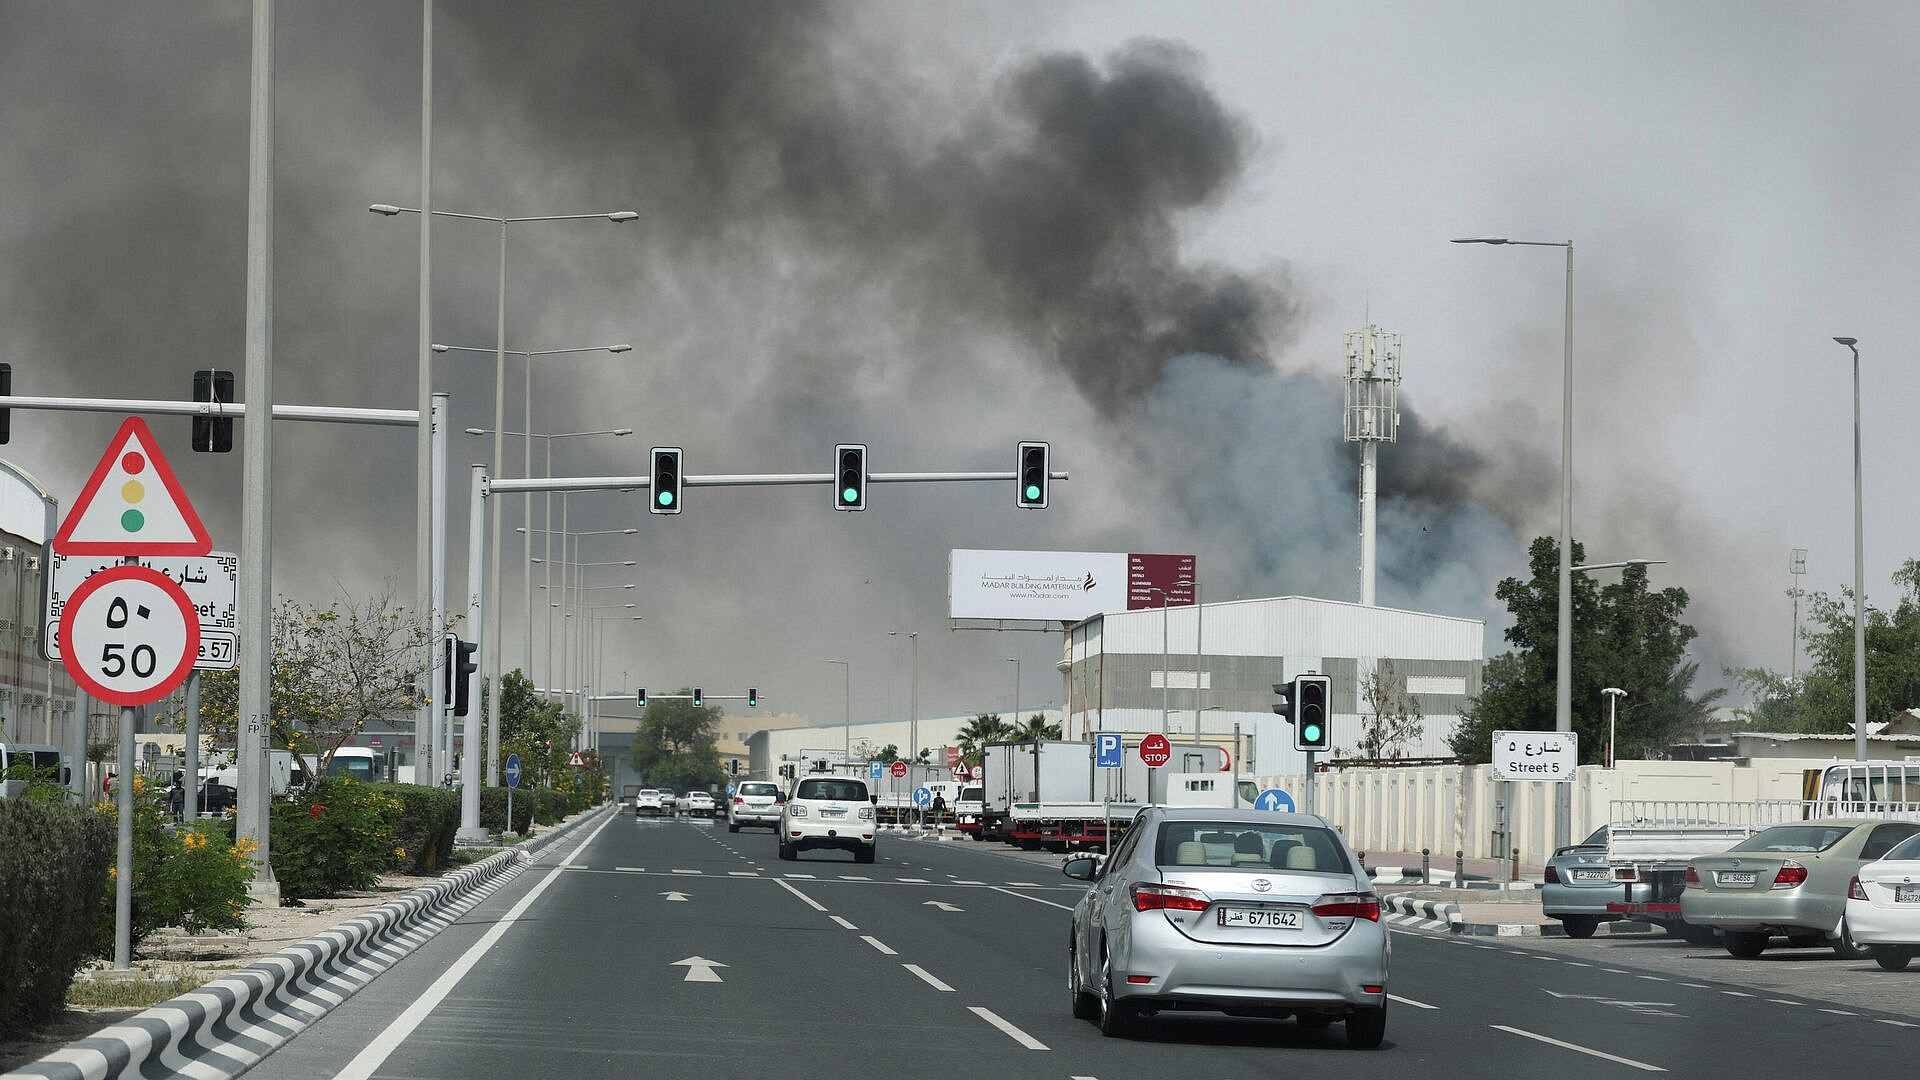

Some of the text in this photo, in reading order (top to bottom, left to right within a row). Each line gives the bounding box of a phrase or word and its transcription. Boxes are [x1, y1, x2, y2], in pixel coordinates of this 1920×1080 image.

[1010, 592, 1070, 600] www.madar.com
[106, 596, 151, 629] ٥٠
[211, 642, 230, 659] 57
[101, 644, 156, 678] 50
[251, 714, 258, 724] Z
[248, 724, 260, 734] FP
[1102, 736, 1117, 756] P
[1146, 740, 1164, 750] قف
[1525, 741, 1562, 756] شارع
[1144, 754, 1168, 762] STOP
[1510, 761, 1560, 773] Street 5
[1228, 912, 1244, 922] قطر
[1248, 912, 1296, 926] 671642
